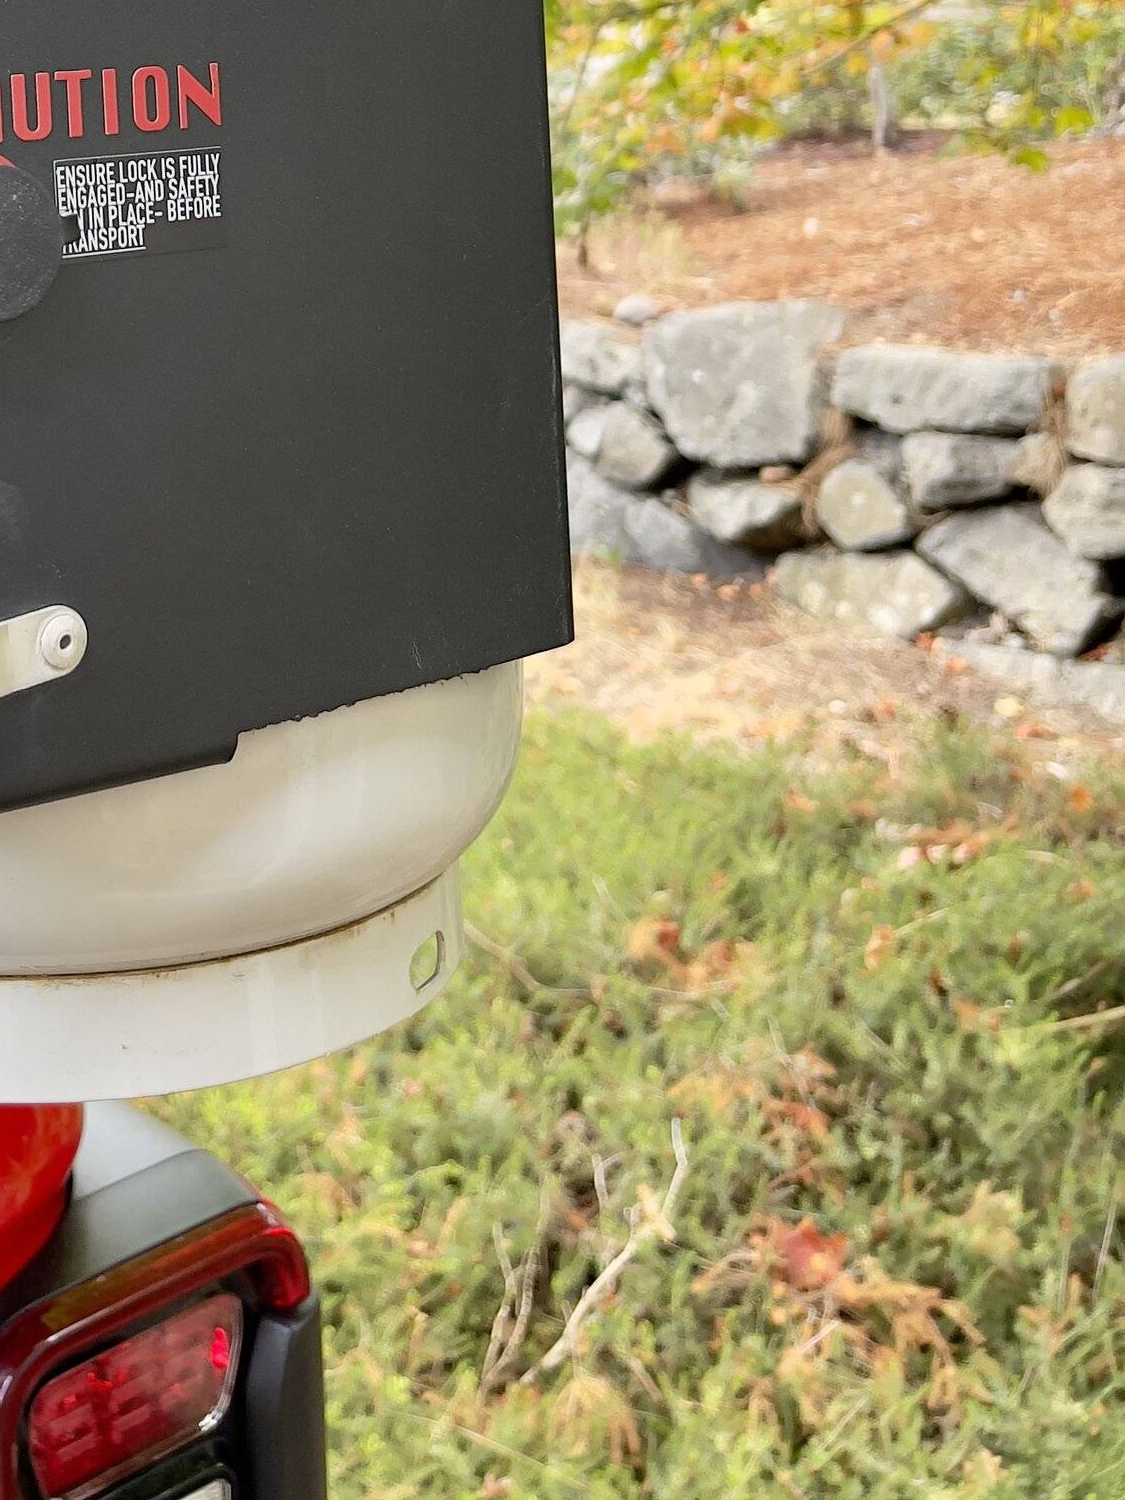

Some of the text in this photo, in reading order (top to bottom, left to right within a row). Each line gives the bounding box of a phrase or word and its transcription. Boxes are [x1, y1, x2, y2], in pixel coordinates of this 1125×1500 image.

[56, 153, 220, 188] ENSURE LOCK IS FULLY
[168, 174, 219, 200] SAFETY
[88, 206, 104, 230] IN
[167, 195, 222, 222] BEFORE
